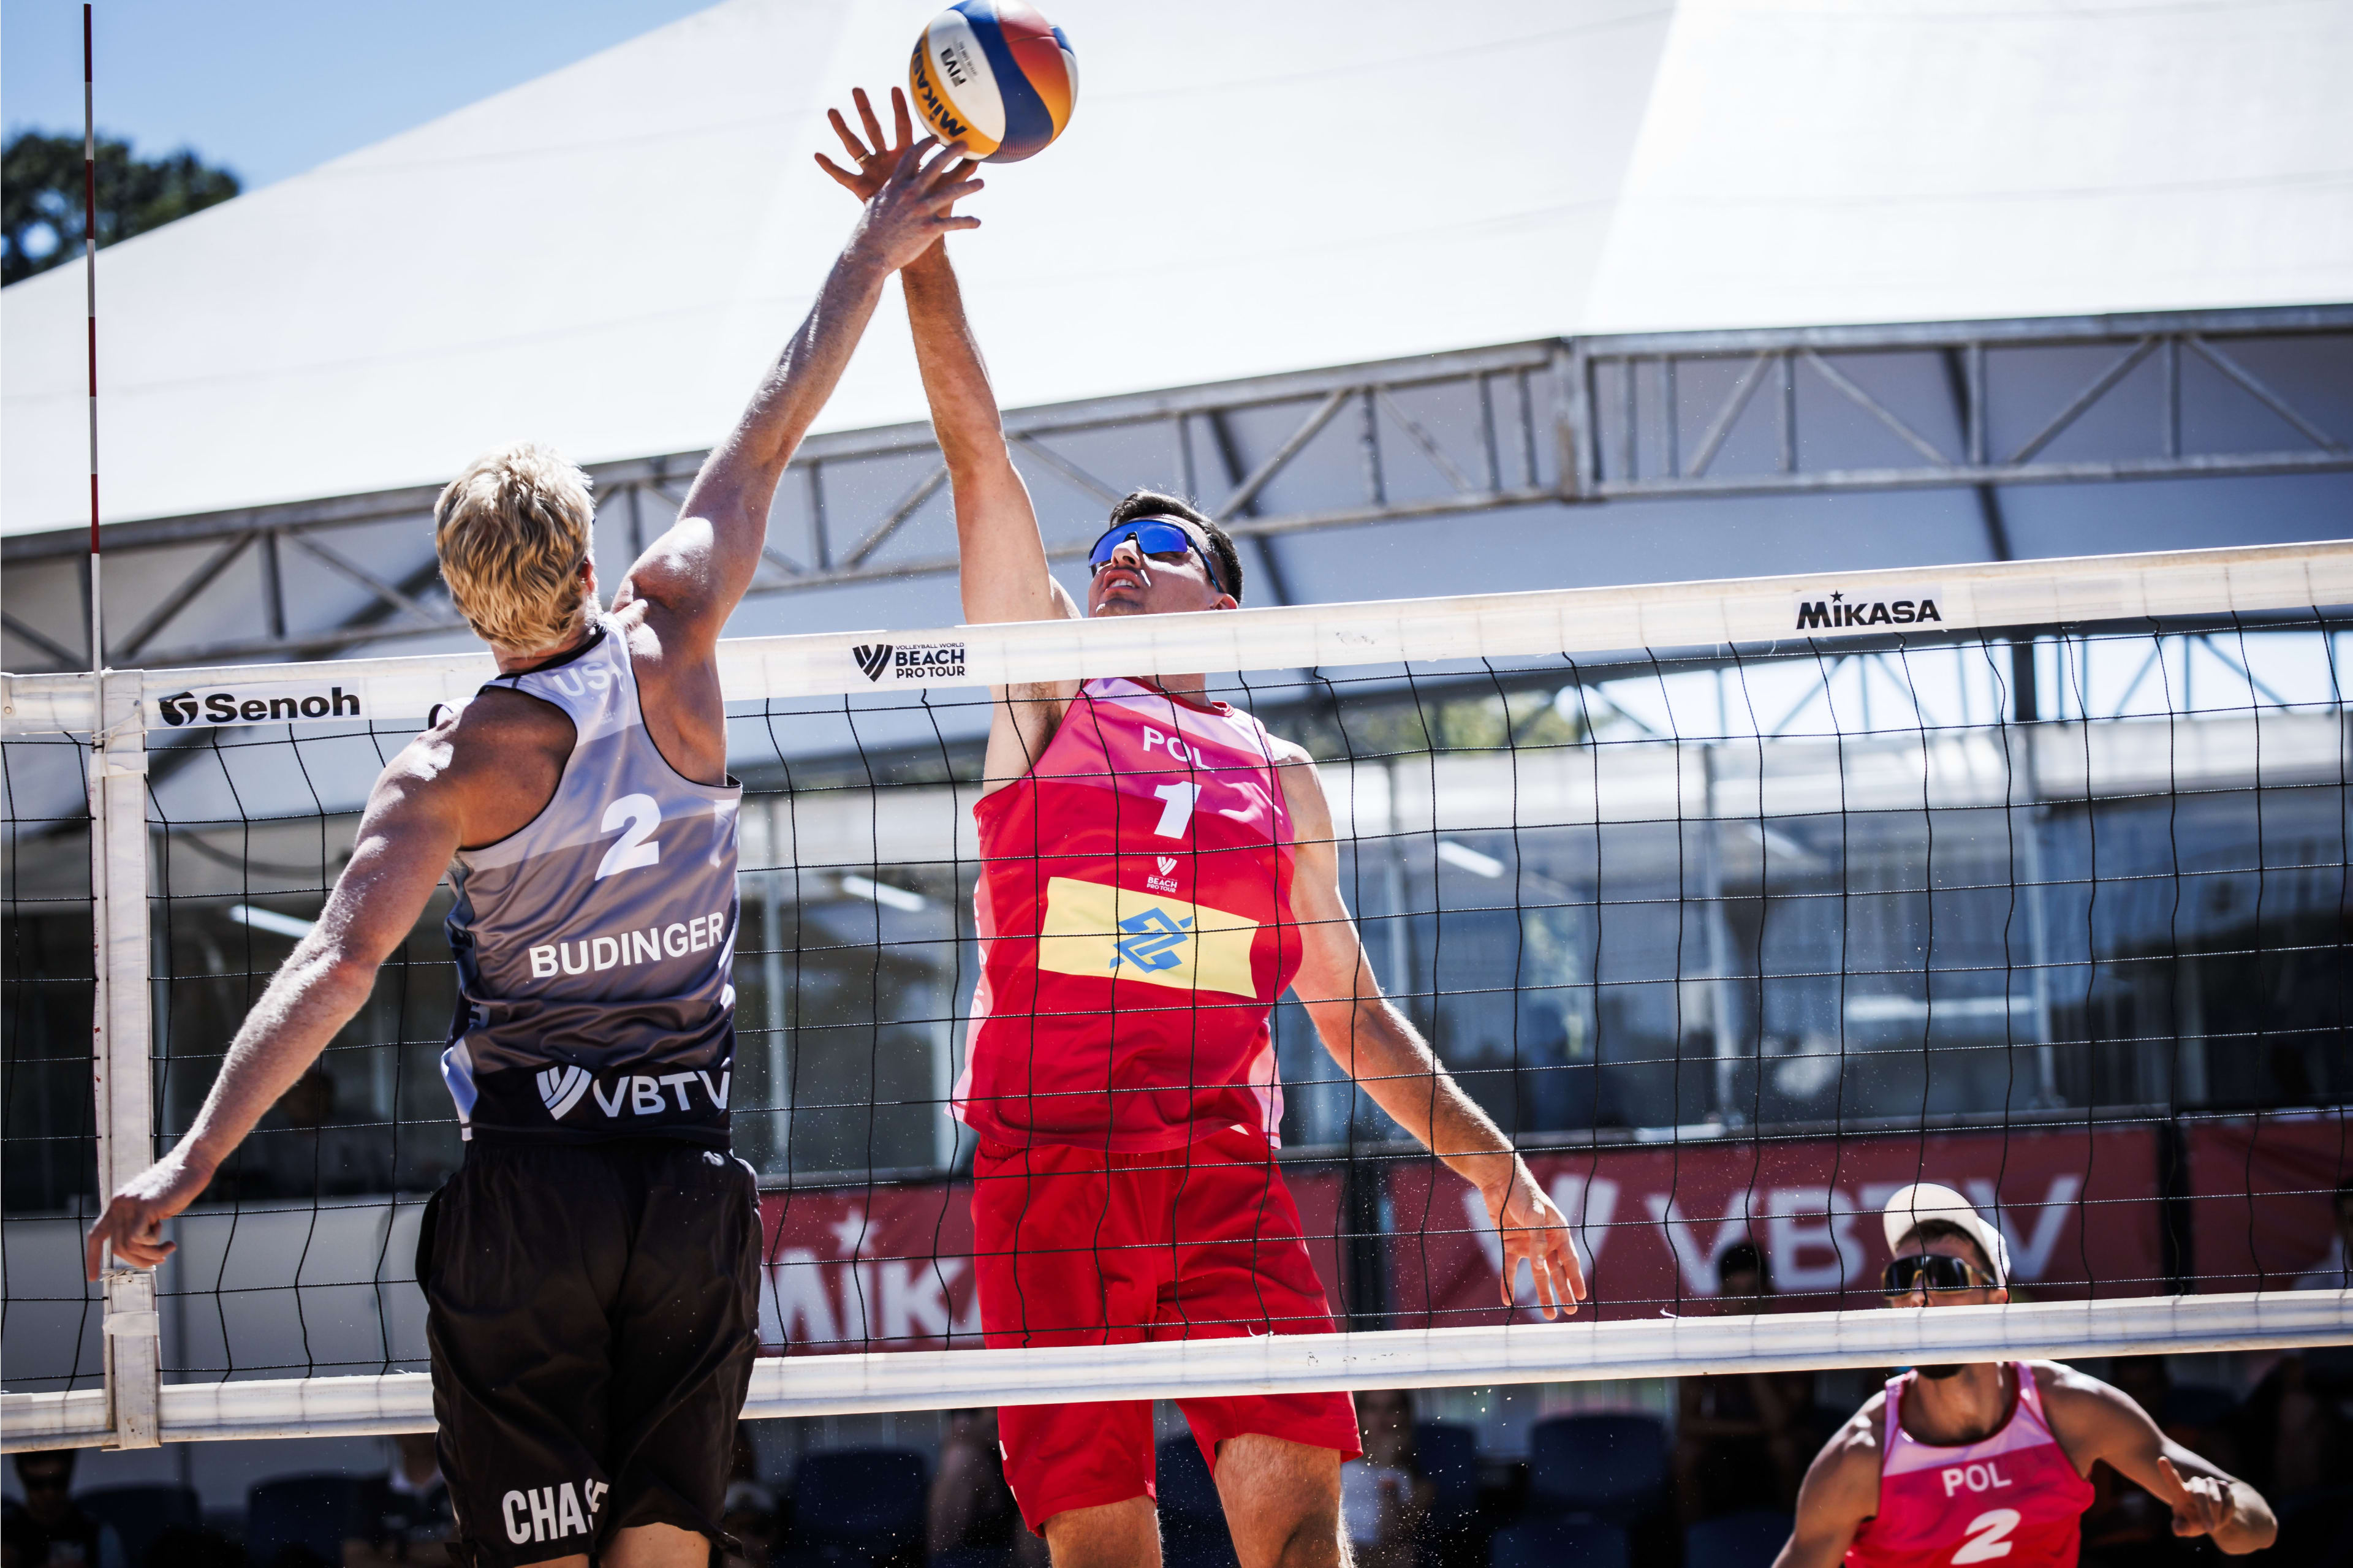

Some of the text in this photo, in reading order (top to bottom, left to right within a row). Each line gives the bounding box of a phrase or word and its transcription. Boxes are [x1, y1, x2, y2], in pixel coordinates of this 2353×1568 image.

[896, 650, 964, 666] BEACH
[896, 666, 965, 678] PRO TOUR
[205, 686, 360, 723] Senoh
[1143, 725, 1214, 773] POL
[1154, 781, 1202, 839] 1
[595, 793, 661, 881] 2
[1148, 876, 1177, 888] BEACH
[529, 912, 724, 978] BUDINGER
[593, 1070, 730, 1118] VBTV
[1650, 1175, 2082, 1295] VBV
[1941, 1462, 2012, 1497] POL
[1950, 1509, 2021, 1566] 2
